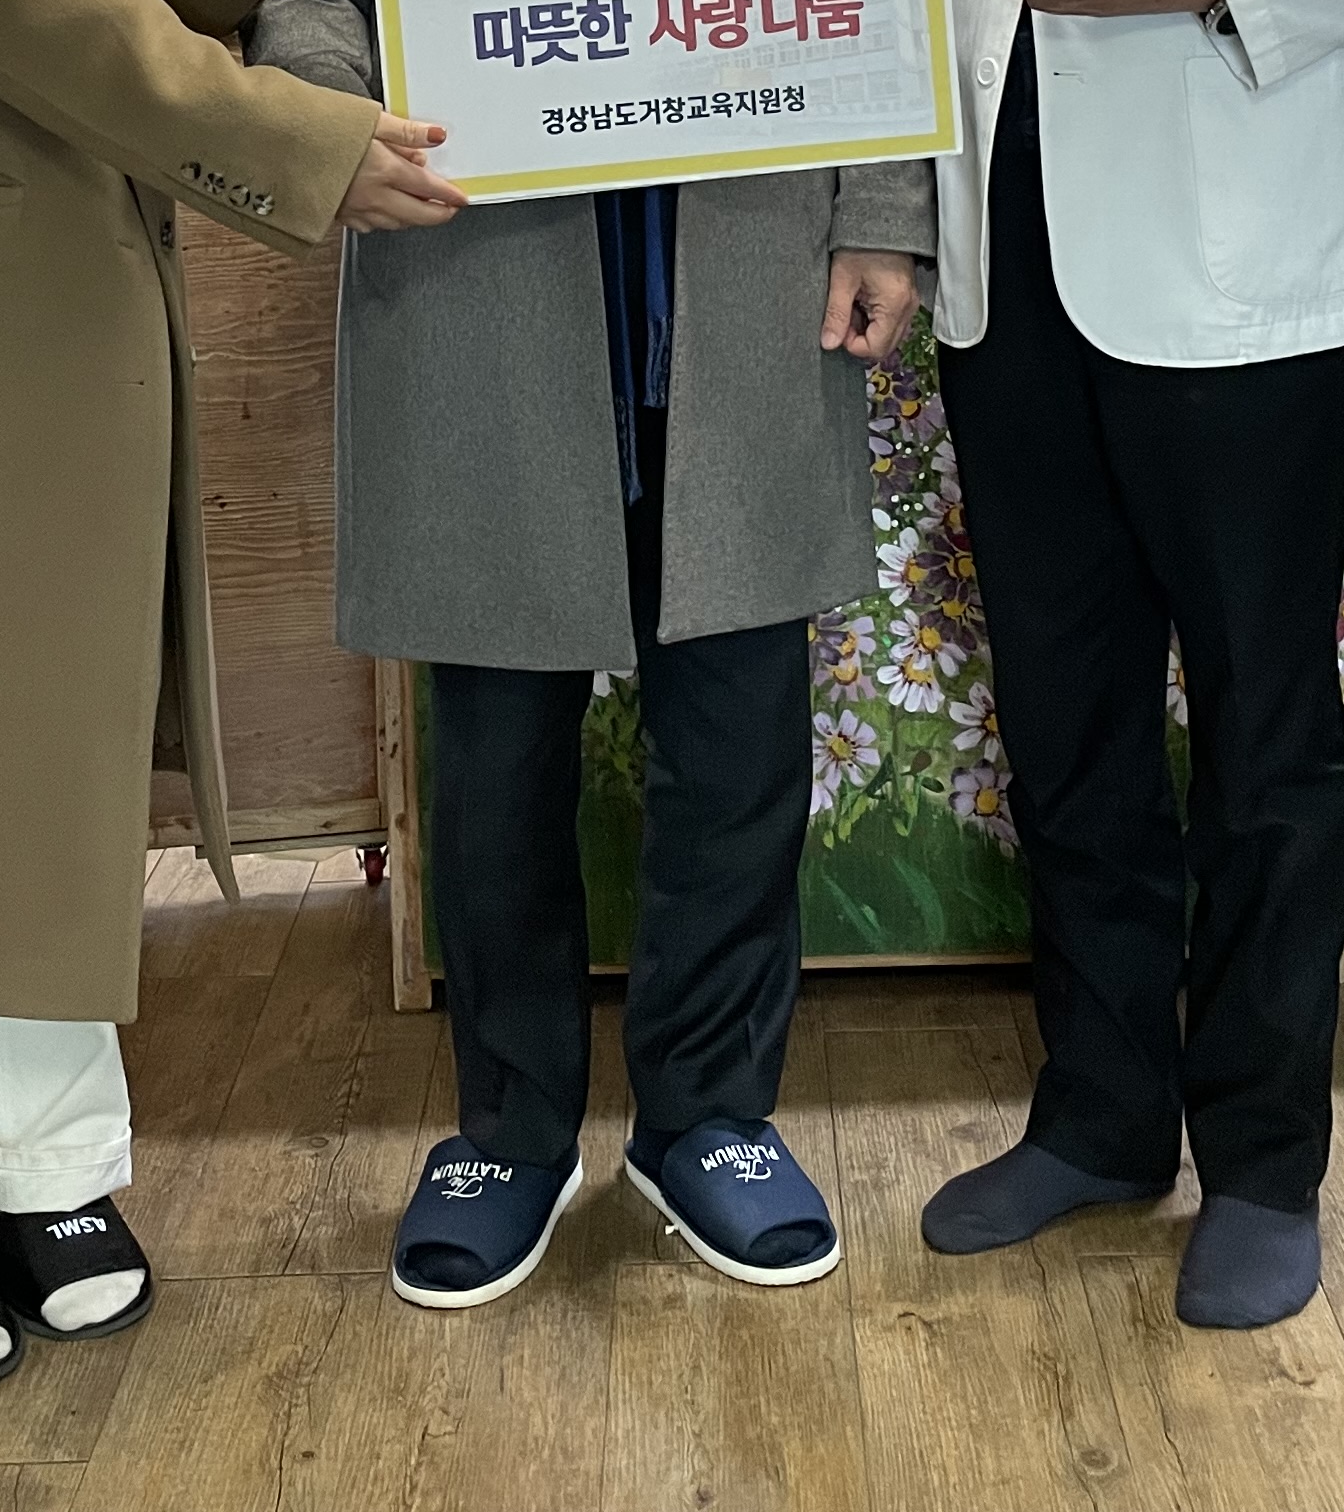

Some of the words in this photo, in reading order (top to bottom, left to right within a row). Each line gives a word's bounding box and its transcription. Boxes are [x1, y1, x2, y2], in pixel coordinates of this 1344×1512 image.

[541, 84, 807, 136] 경상남도거창교육지원청
[431, 1159, 514, 1183] PLATINUM
[700, 1144, 780, 1172] PLATINUM
[46, 1216, 108, 1240] ASML
